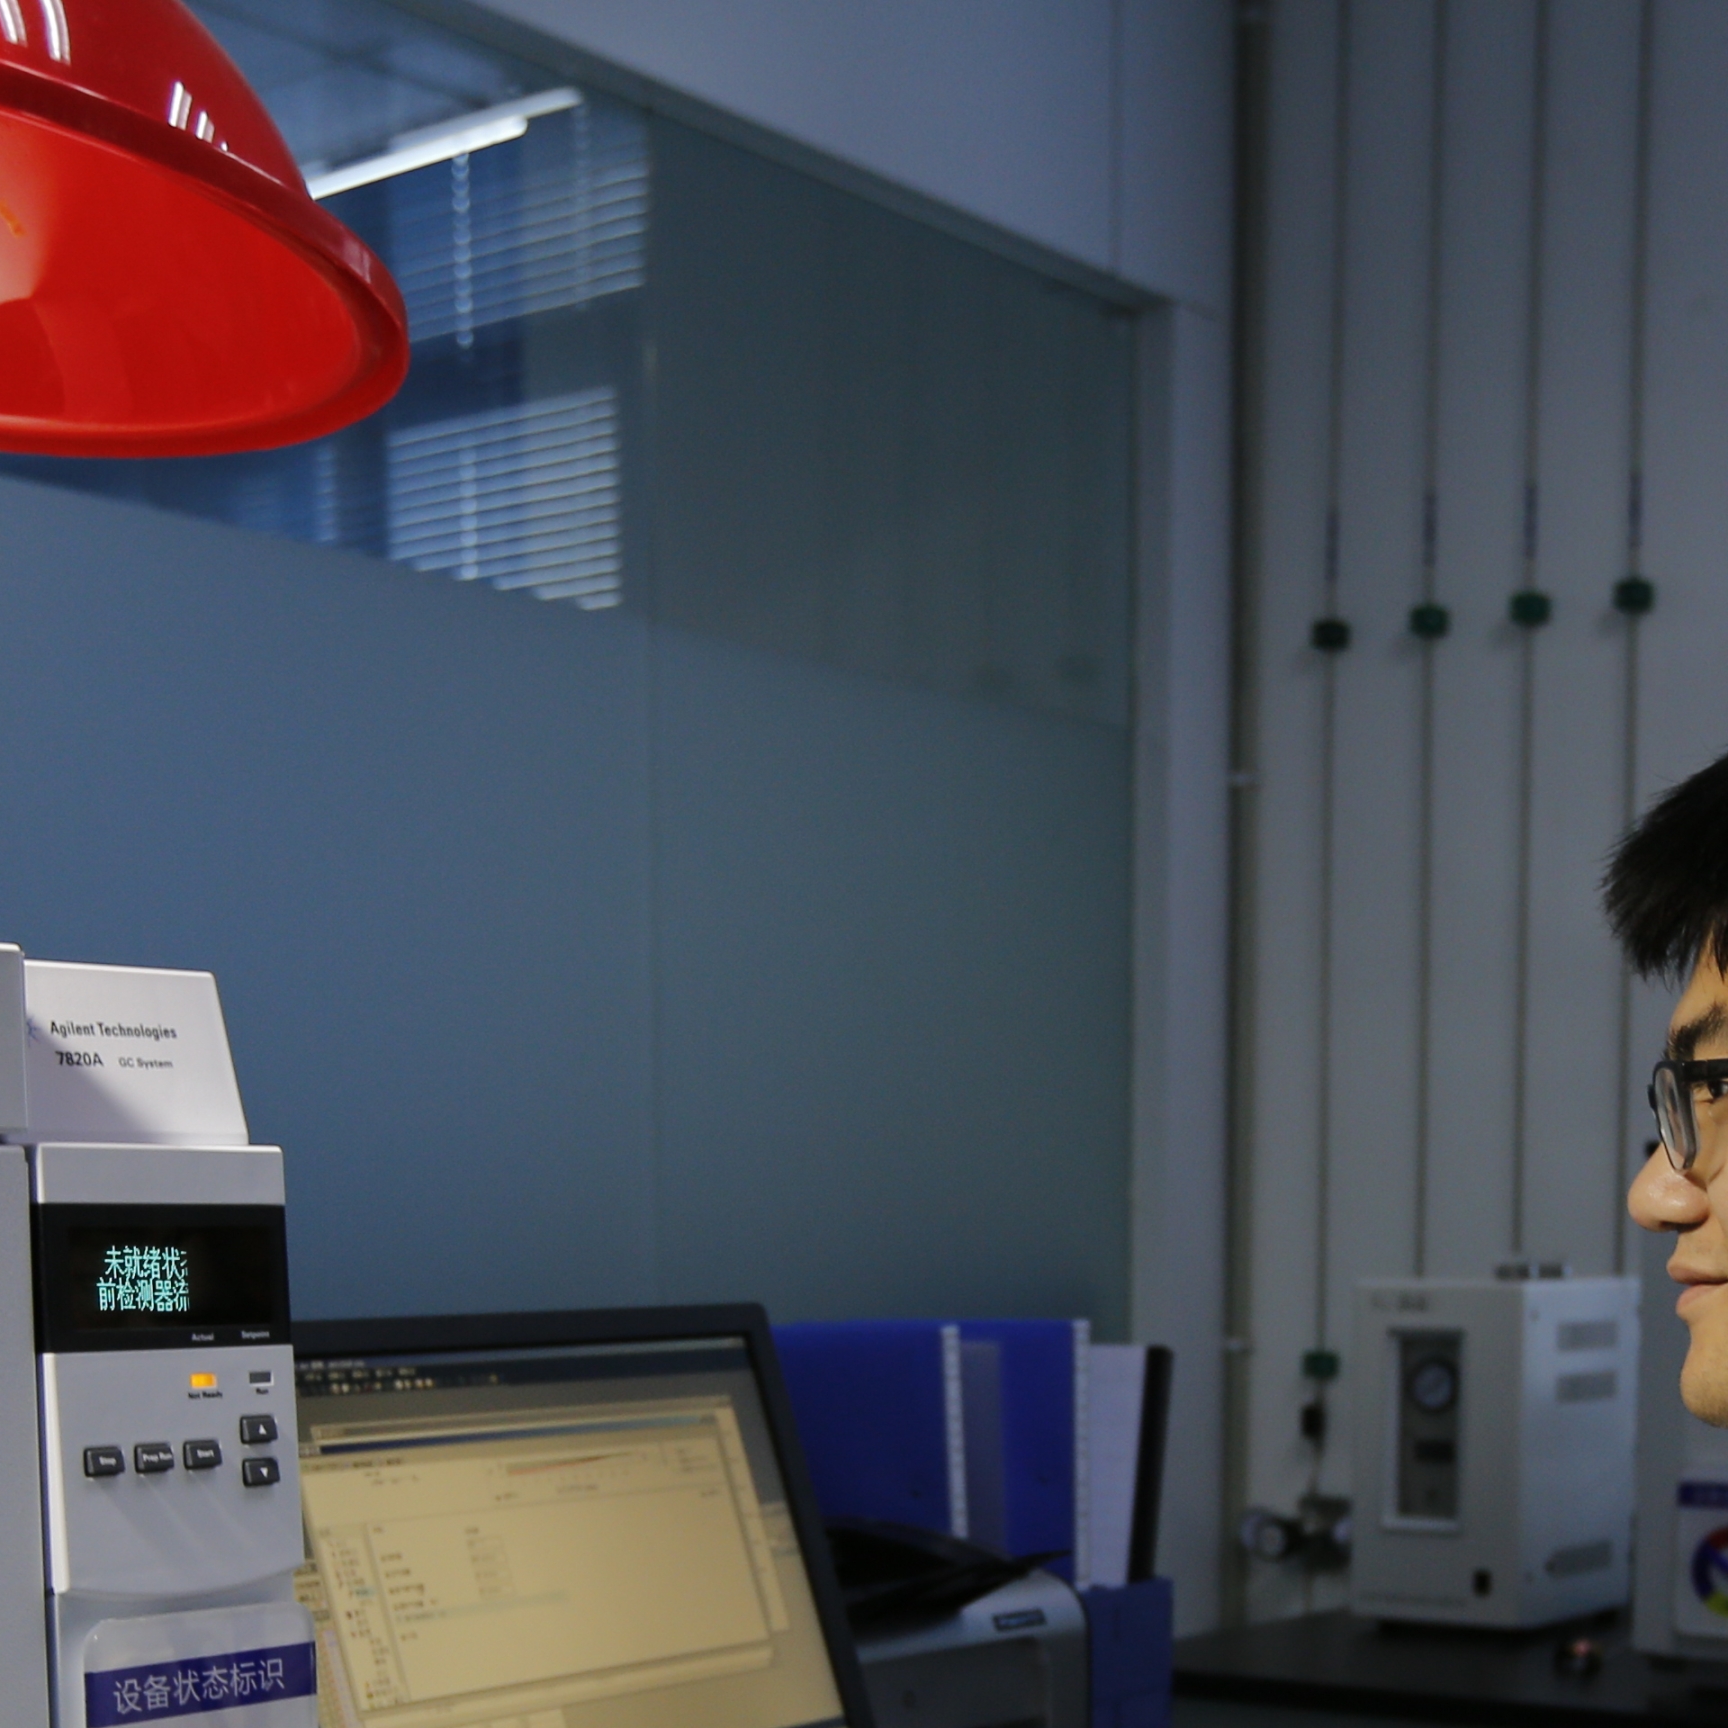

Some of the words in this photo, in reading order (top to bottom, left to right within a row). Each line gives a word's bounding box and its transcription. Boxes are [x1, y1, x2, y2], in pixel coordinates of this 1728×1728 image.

[50, 1020, 95, 1039] Agilent
[97, 1022, 177, 1041] Technologies
[55, 1051, 103, 1067] 7820A
[137, 1057, 173, 1070] System
[113, 1658, 286, 1715] 设备状态标识
